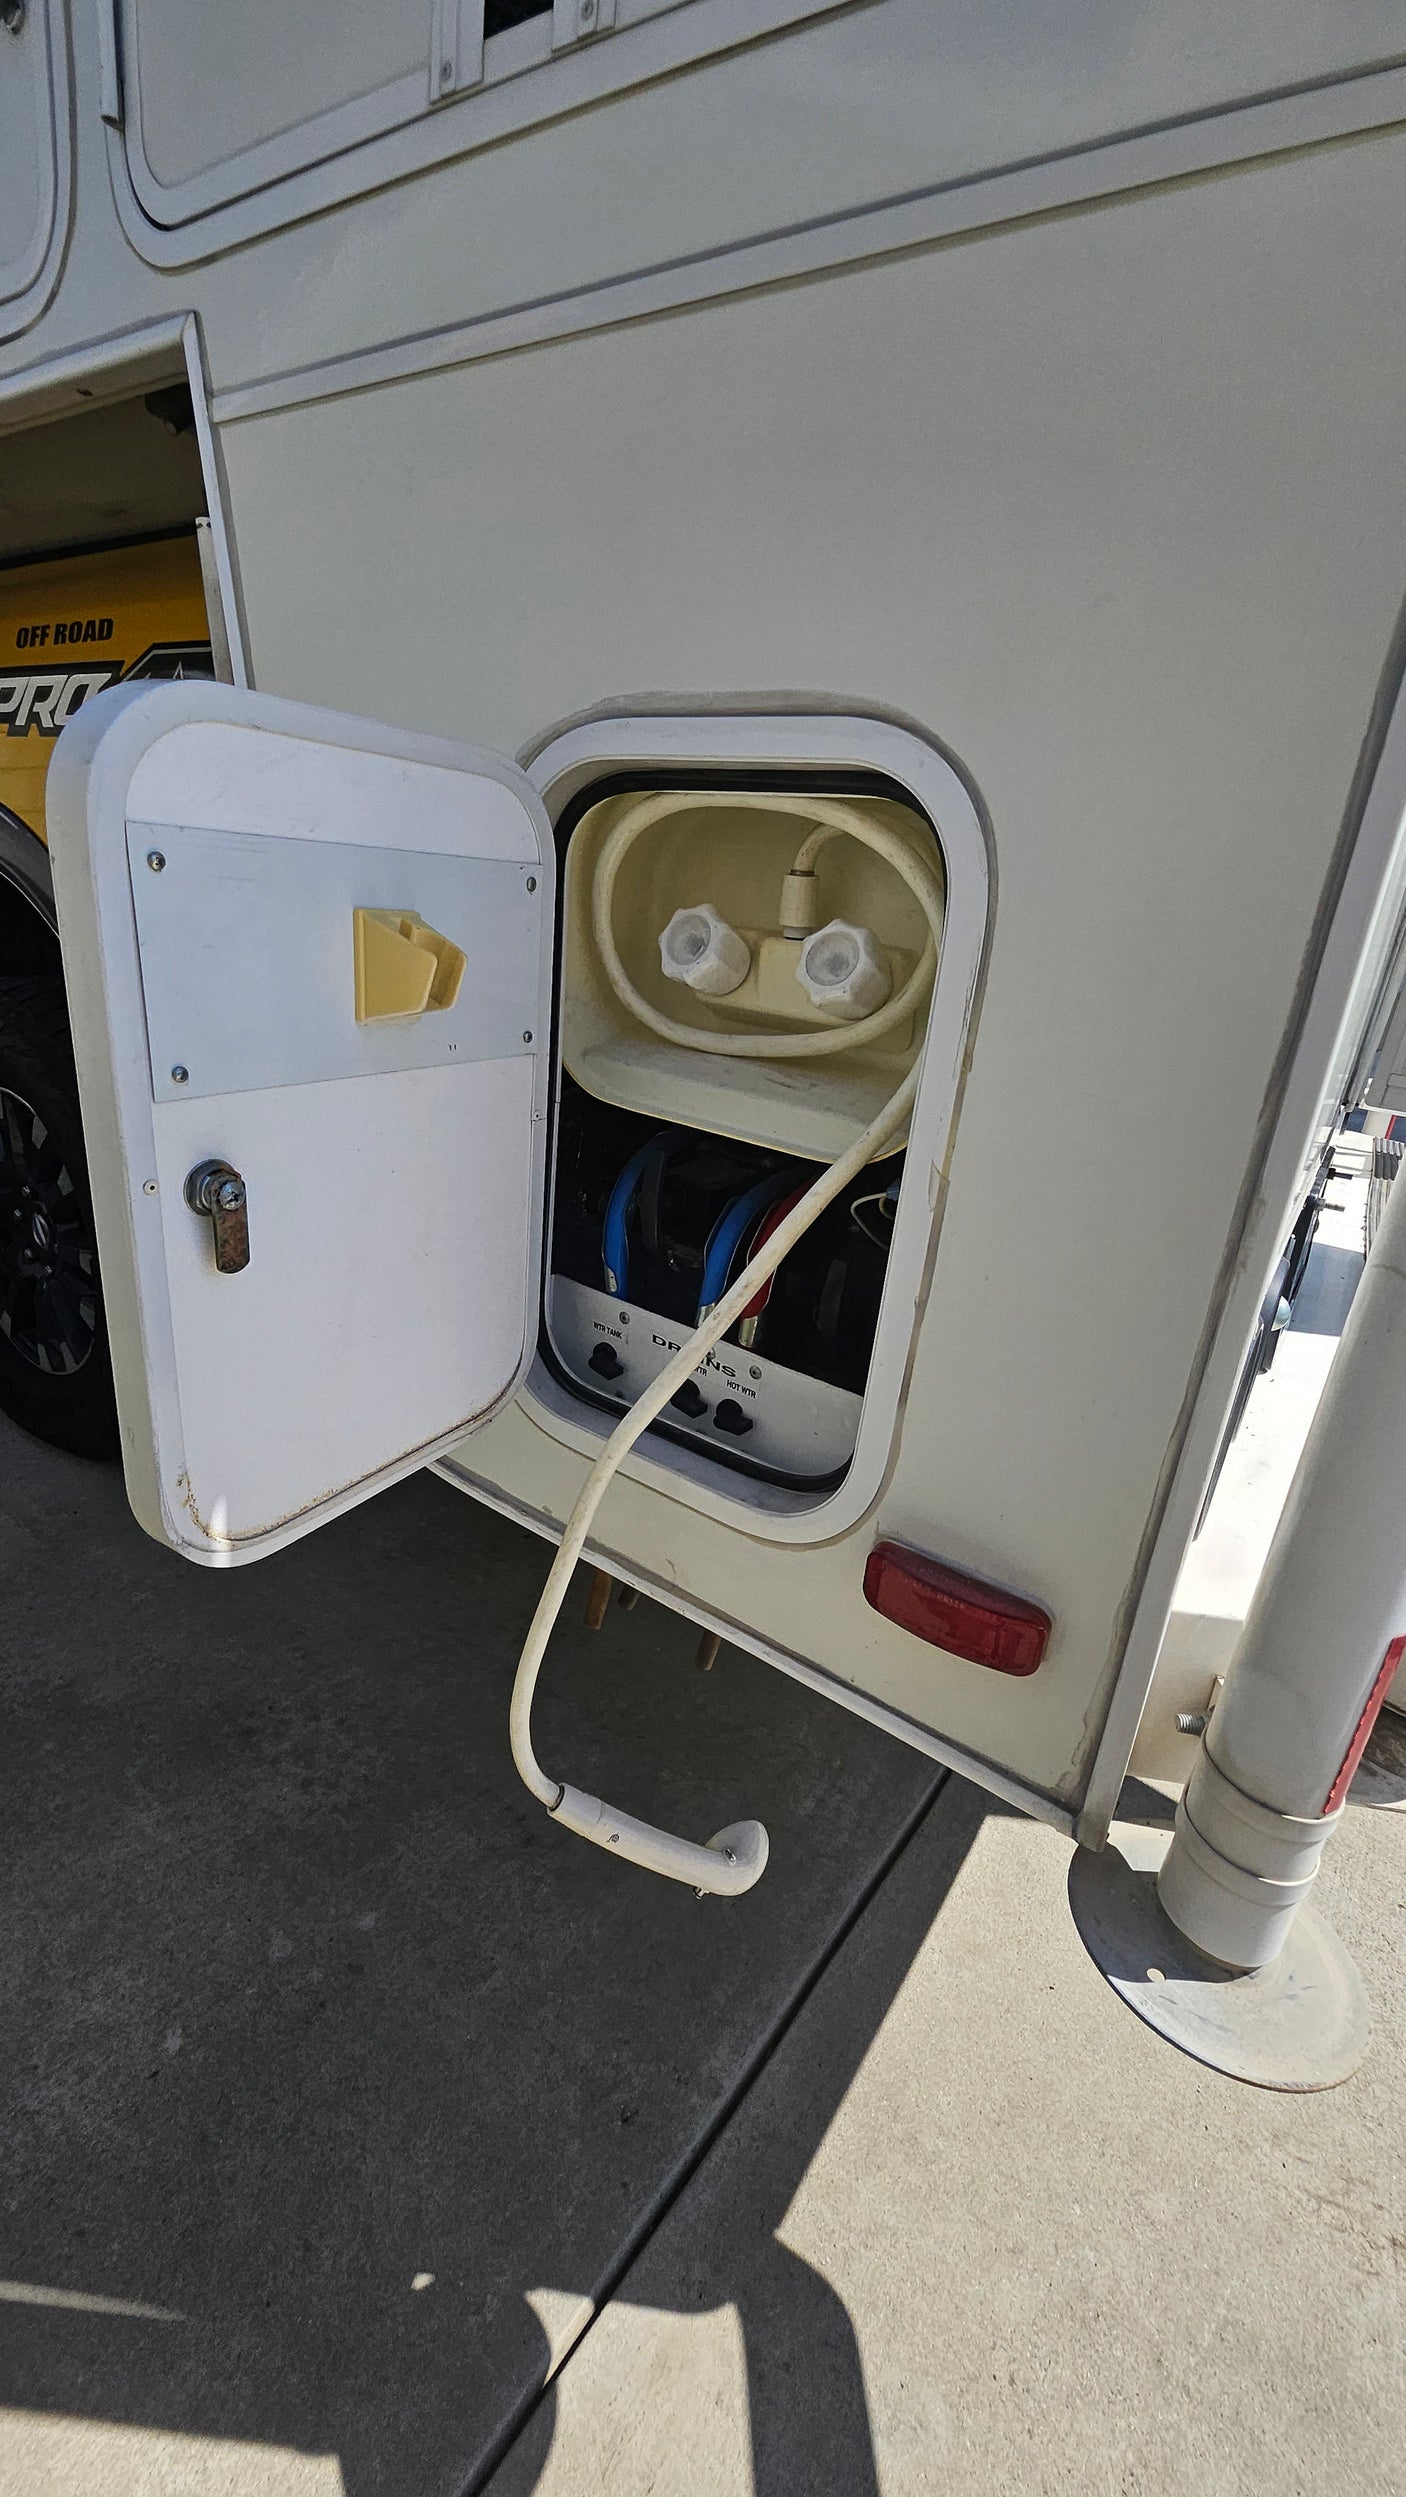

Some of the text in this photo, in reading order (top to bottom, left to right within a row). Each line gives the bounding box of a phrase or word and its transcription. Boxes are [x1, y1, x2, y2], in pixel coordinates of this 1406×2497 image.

[16, 618, 114, 649] OFF ROAD
[593, 1321, 622, 1340] WTR TANK
[652, 1334, 736, 1377] DRNS
[726, 1379, 756, 1399] HOT WTR
